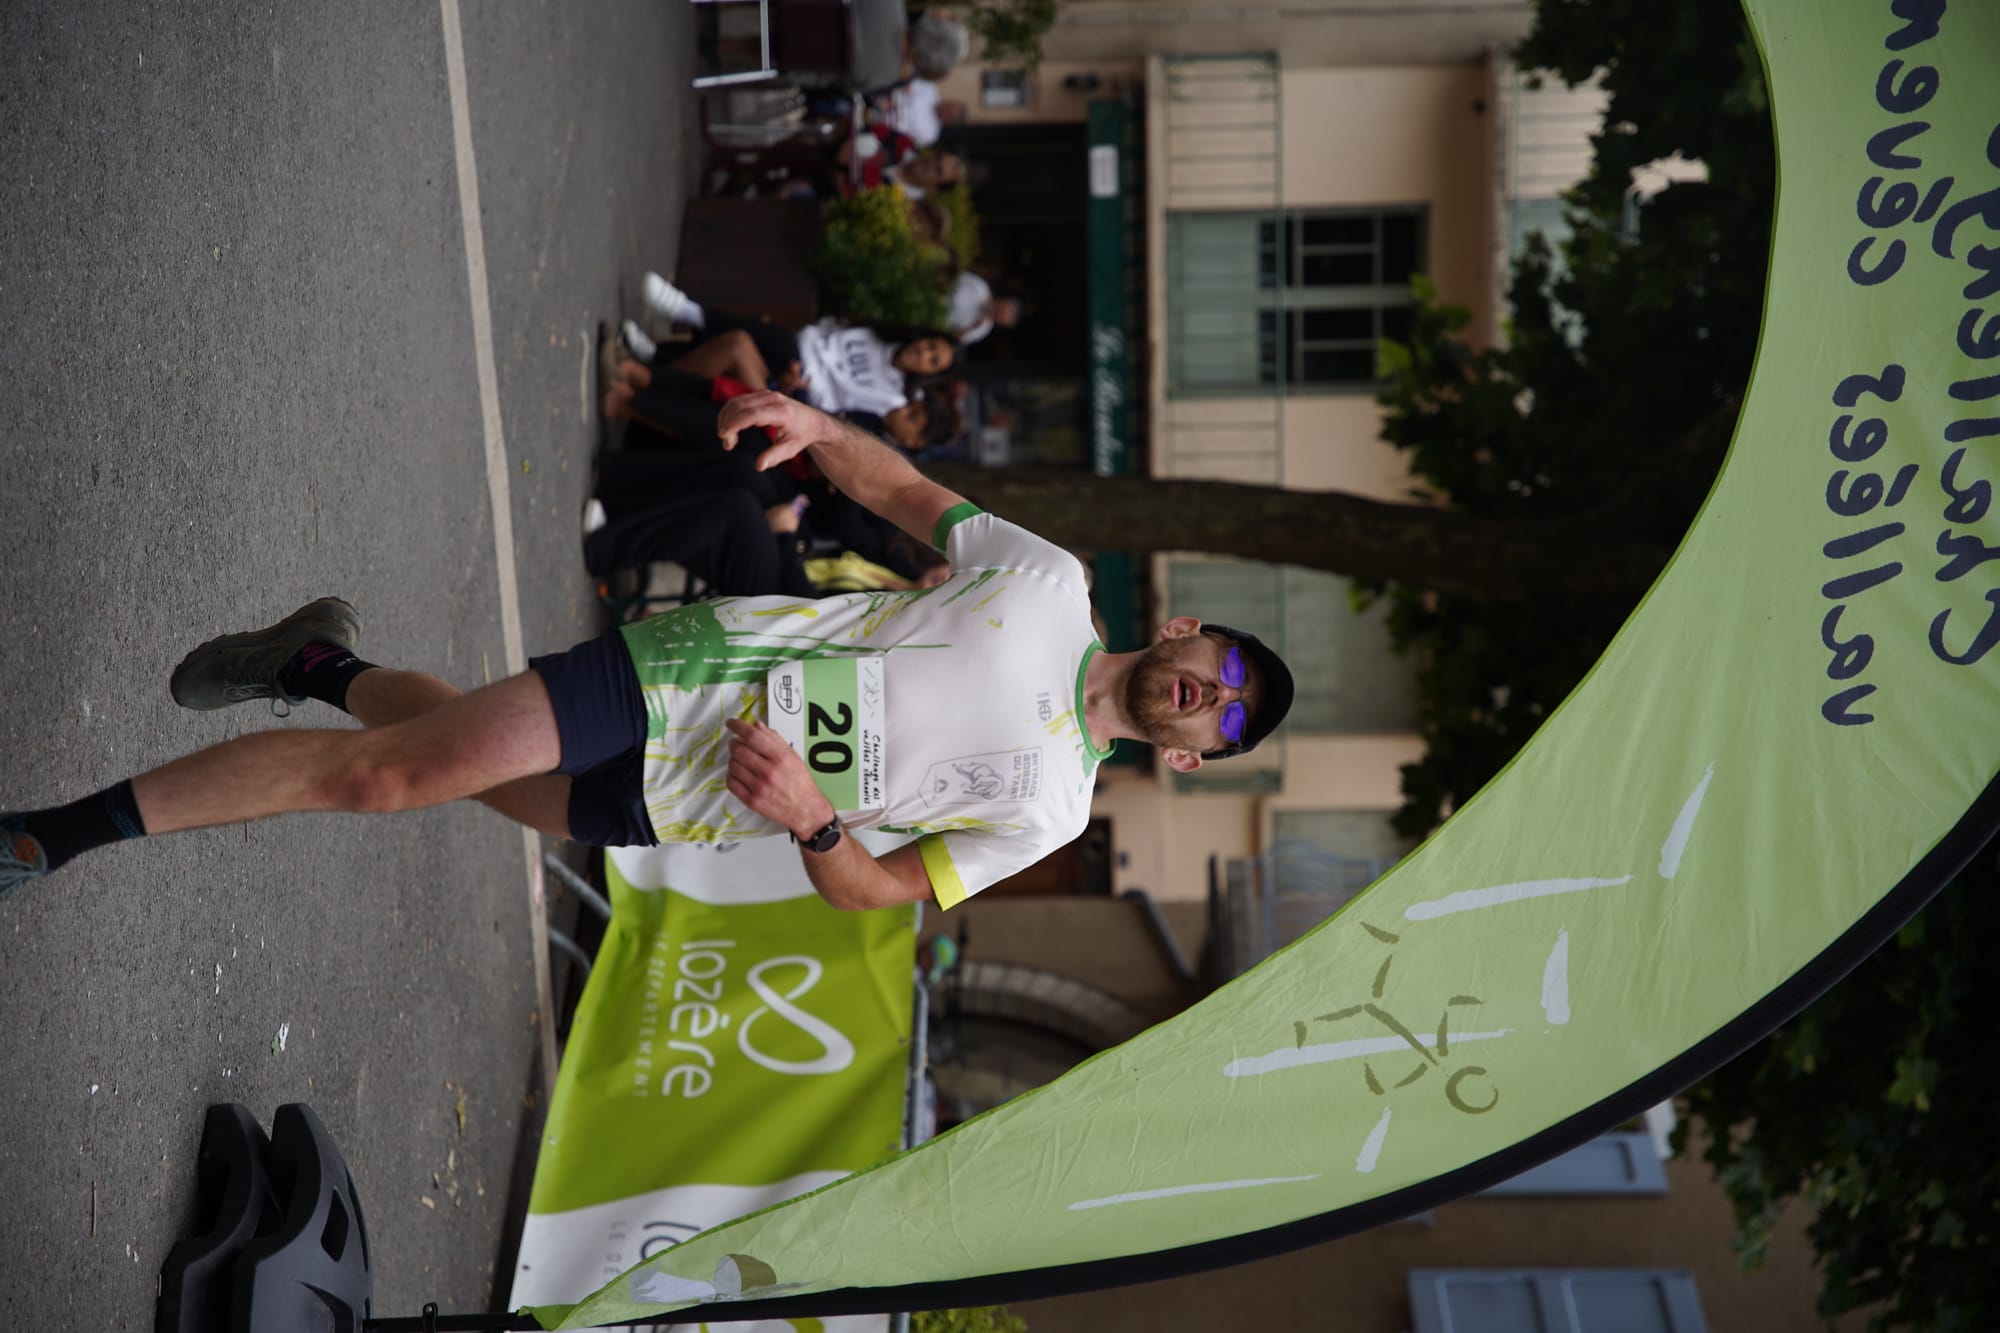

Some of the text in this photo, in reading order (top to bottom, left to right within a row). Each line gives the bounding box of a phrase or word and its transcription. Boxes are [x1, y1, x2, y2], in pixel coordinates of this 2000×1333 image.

[782, 675, 793, 709] BFP
[808, 702, 853, 774] 20
[869, 734, 881, 782] Challenge
[1014, 755, 1022, 770] DU
[662, 940, 736, 1098] lozère
